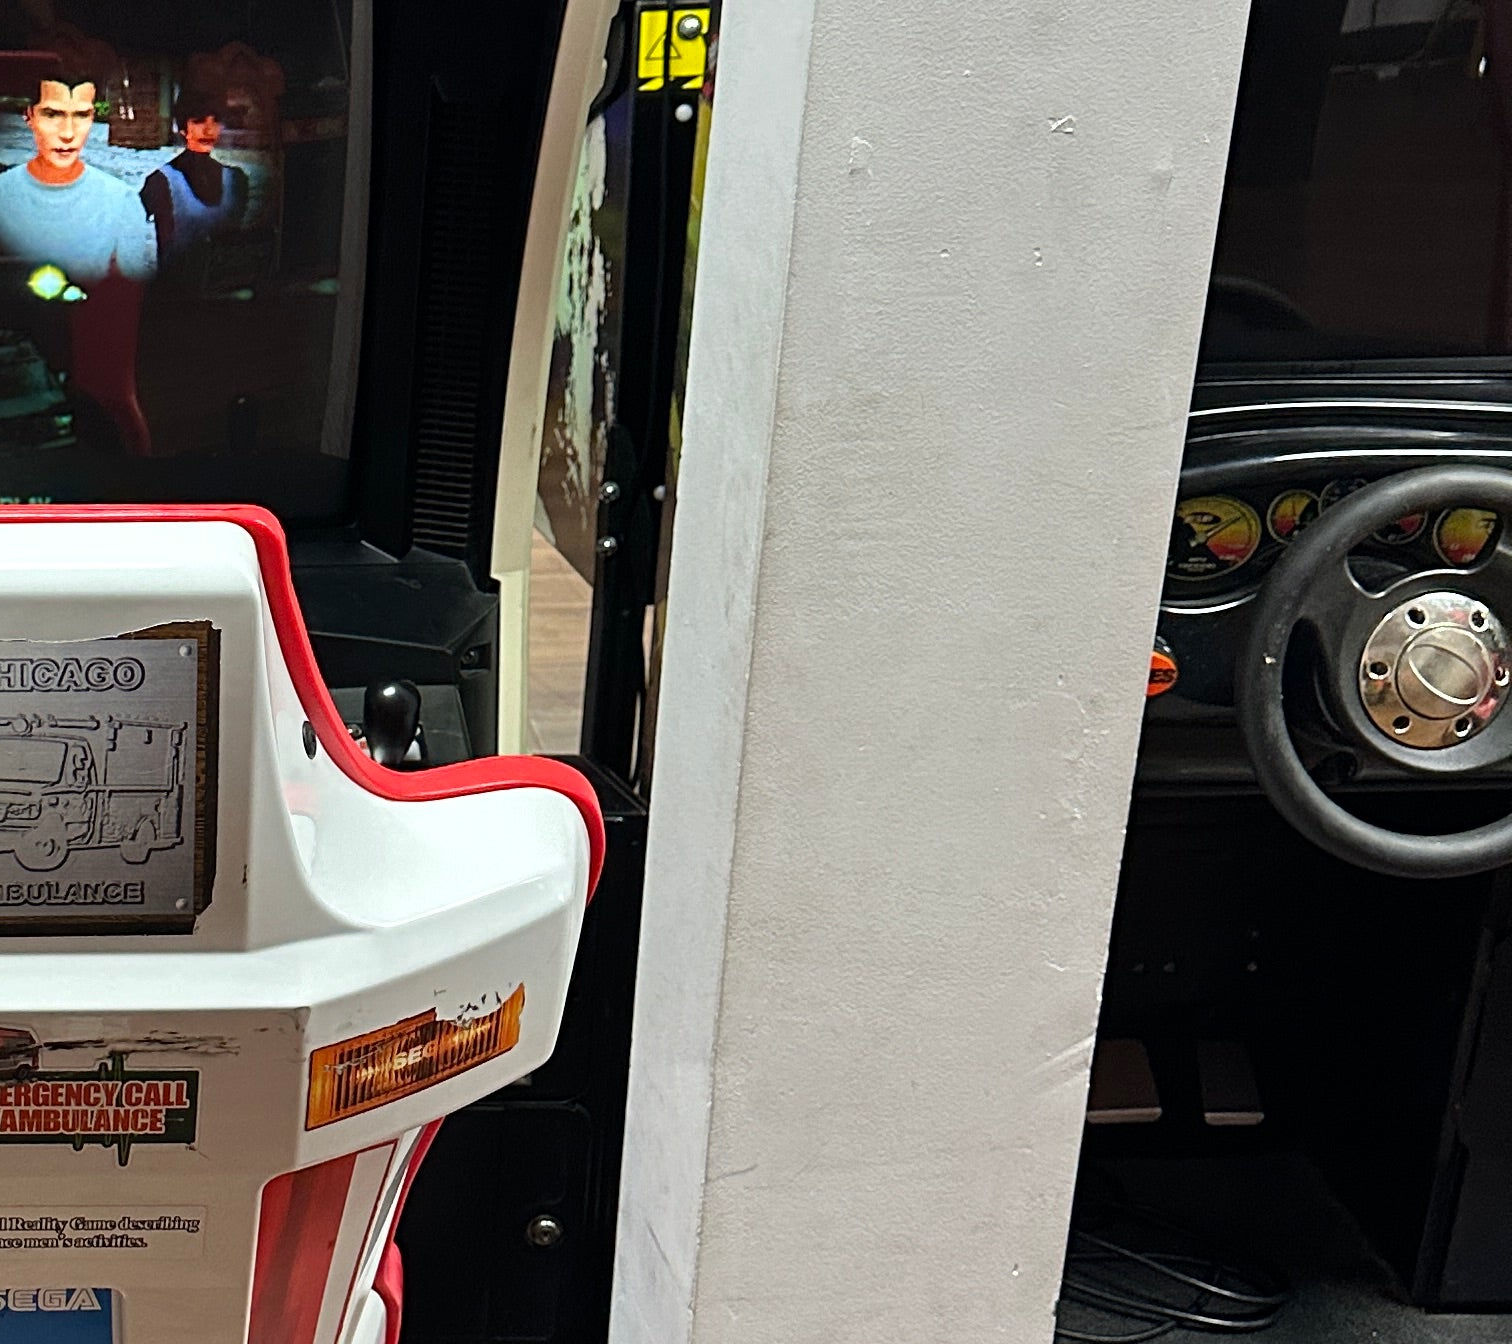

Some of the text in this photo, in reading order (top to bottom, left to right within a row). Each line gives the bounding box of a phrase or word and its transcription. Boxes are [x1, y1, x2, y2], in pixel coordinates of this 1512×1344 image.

[125, 1081, 188, 1108] CALL
[9, 1217, 68, 1235] Reality
[70, 1217, 116, 1232] Game
[118, 1216, 200, 1233] describing
[24, 1233, 73, 1248] men's
[74, 1235, 148, 1248] activities.
